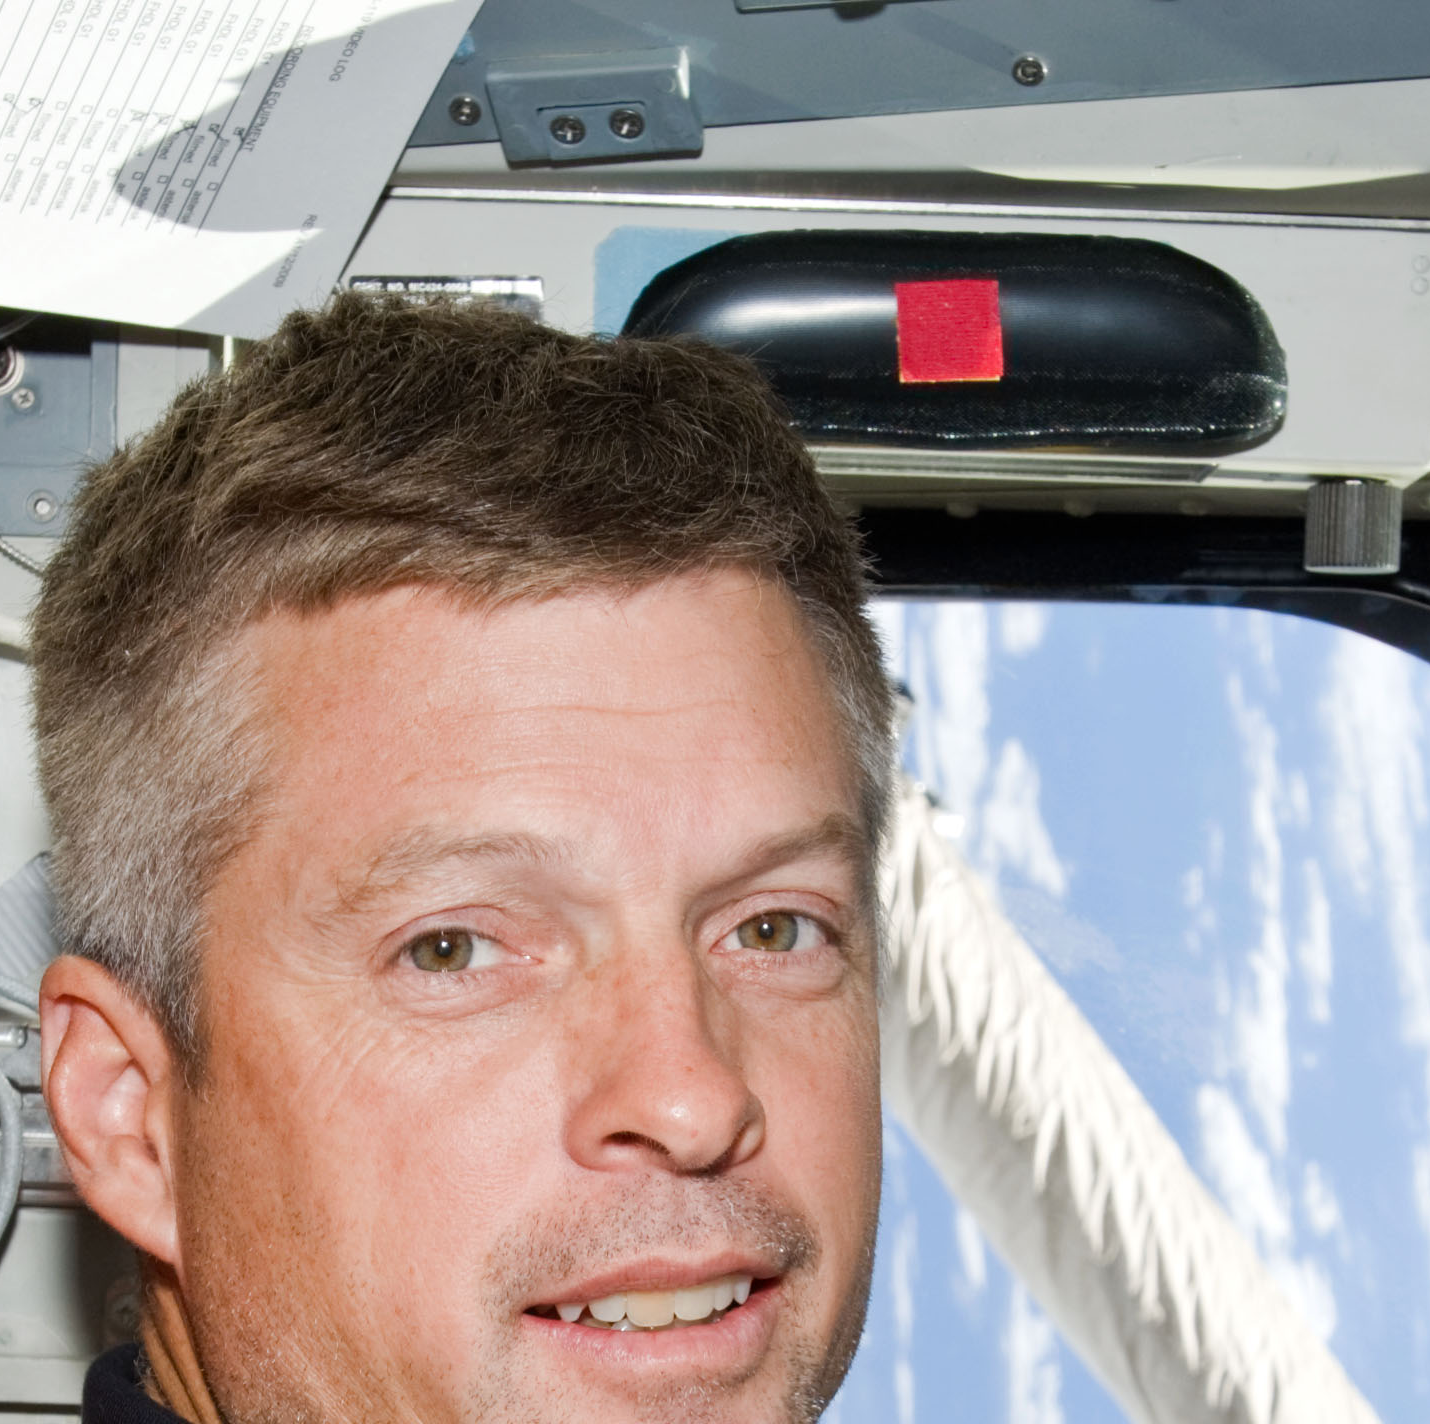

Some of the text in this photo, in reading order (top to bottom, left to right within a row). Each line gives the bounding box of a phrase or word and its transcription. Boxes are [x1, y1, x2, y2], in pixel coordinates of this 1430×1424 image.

[329, 57, 347, 82] LOG
[245, 25, 315, 152] RECORDING EQUIPMENT
[5, 109, 27, 137] filmed
[82, 120, 104, 149] filmed
[182, 135, 205, 164] filmed
[207, 139, 231, 168] filmed
